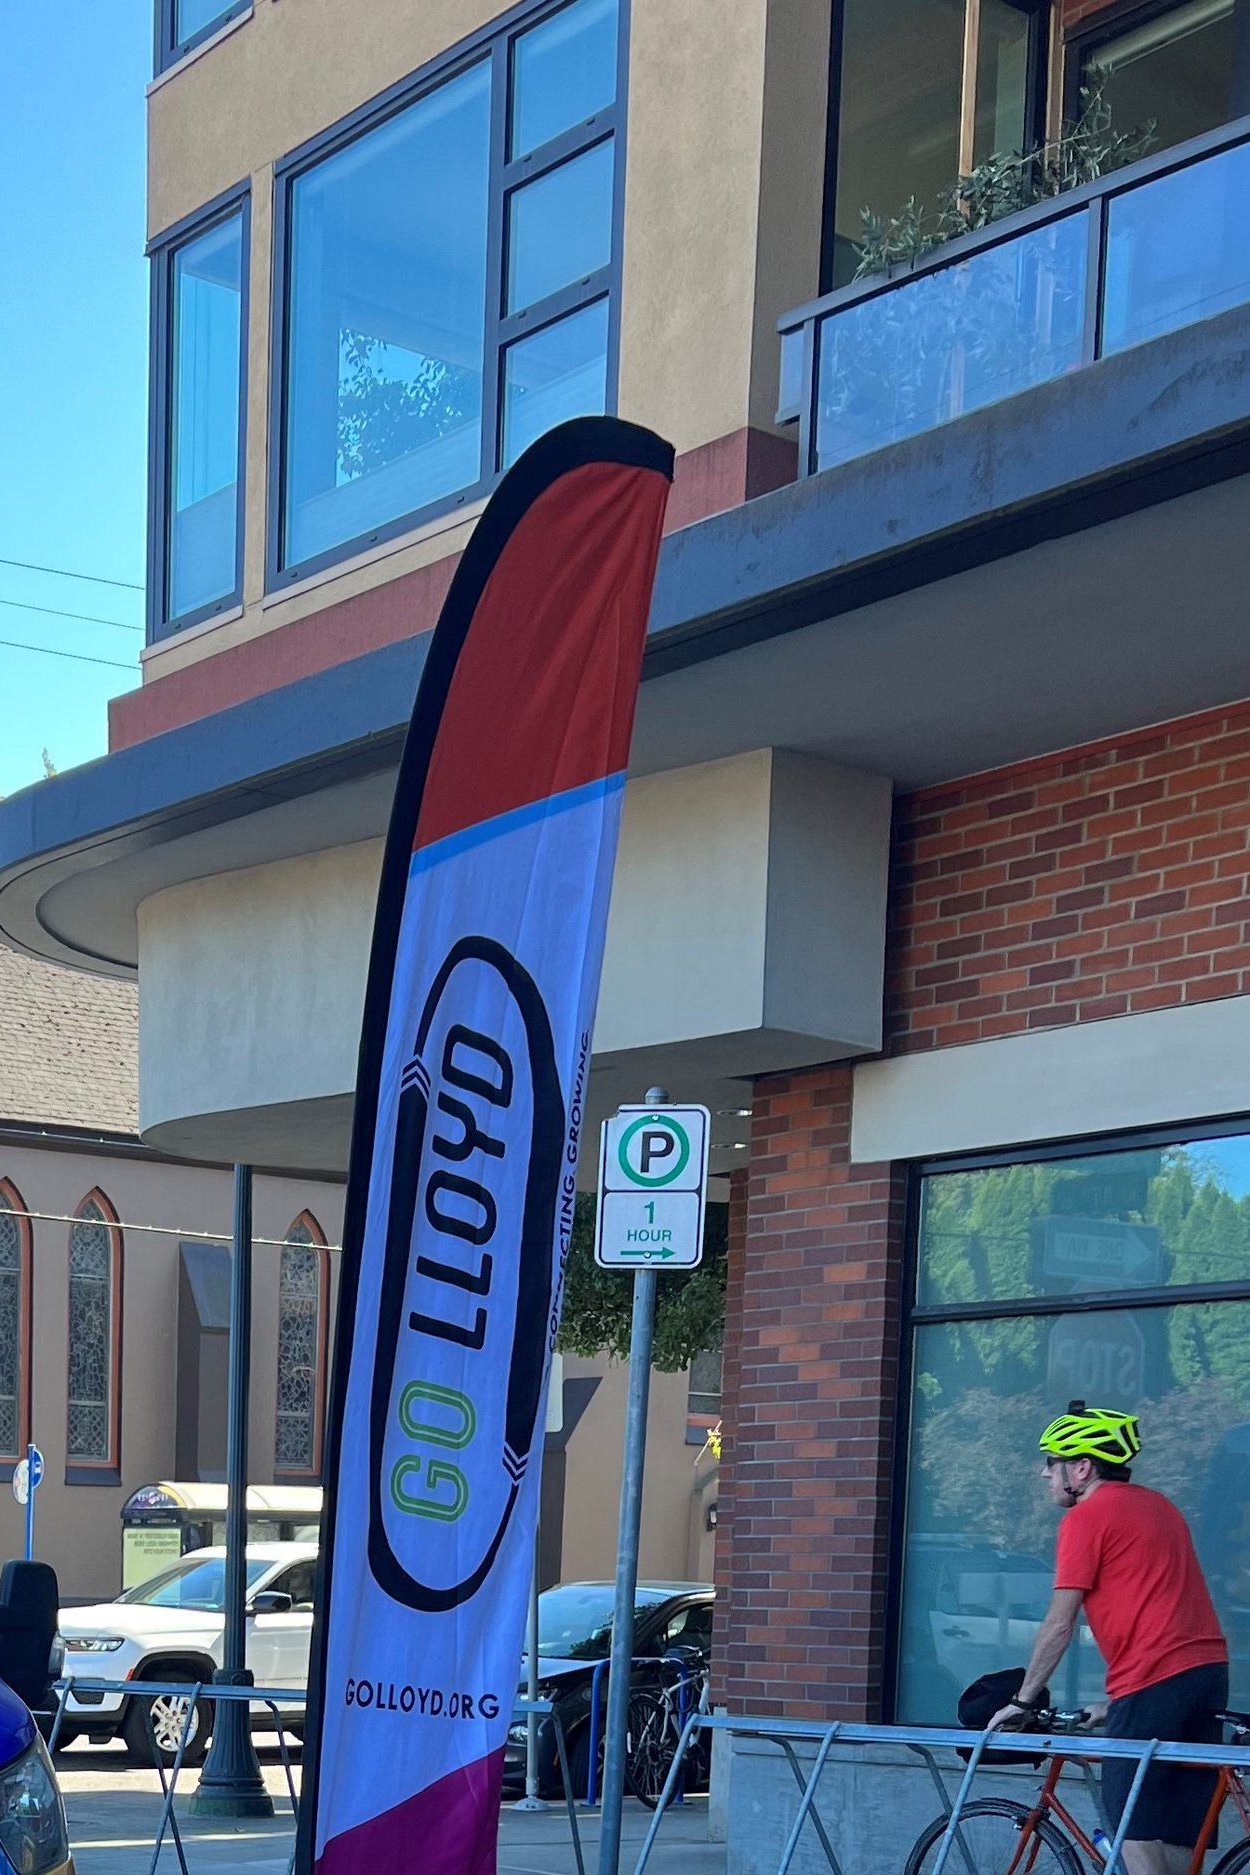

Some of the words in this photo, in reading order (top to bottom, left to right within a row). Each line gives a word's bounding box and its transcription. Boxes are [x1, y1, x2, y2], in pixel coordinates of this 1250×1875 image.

[641, 1131, 675, 1173] P
[409, 1023, 513, 1351] LLOYD
[644, 1200, 655, 1224] 1
[627, 1228, 672, 1242] HOUR
[391, 1379, 476, 1524] GO
[345, 1678, 500, 1719] GOLLOYD.ORG
